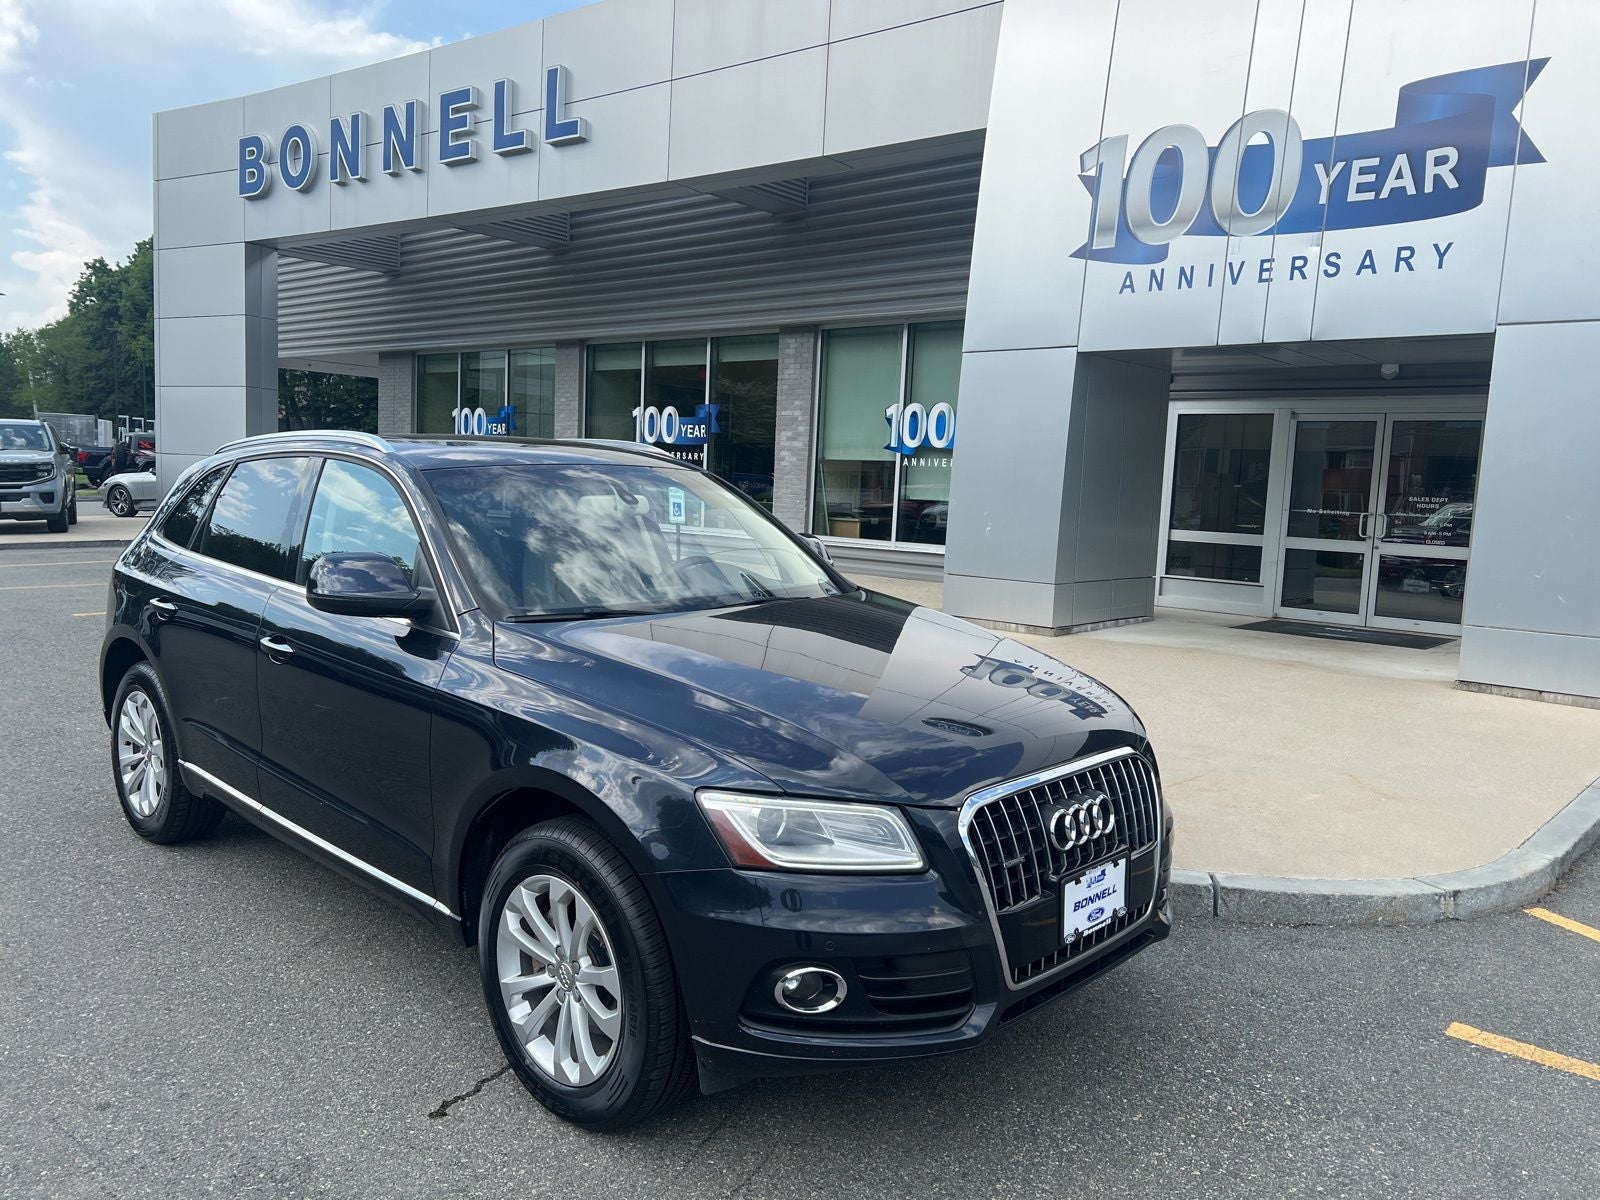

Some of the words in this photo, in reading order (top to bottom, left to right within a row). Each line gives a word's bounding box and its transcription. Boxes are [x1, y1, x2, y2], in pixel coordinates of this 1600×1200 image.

[238, 65, 588, 200] BONNELL
[1080, 109, 1303, 249] 100
[1313, 146, 1460, 205] YEAR
[1119, 242, 1454, 294] ANNIVERSARY
[452, 407, 487, 435] 100
[487, 423, 507, 435] YEAR
[632, 405, 680, 444] 100
[680, 424, 707, 438] YEAR
[885, 402, 955, 449] 100
[668, 451, 704, 461] ERSARY
[1073, 884, 1117, 912] BONNELL
[1083, 917, 1112, 937] Bonnell
